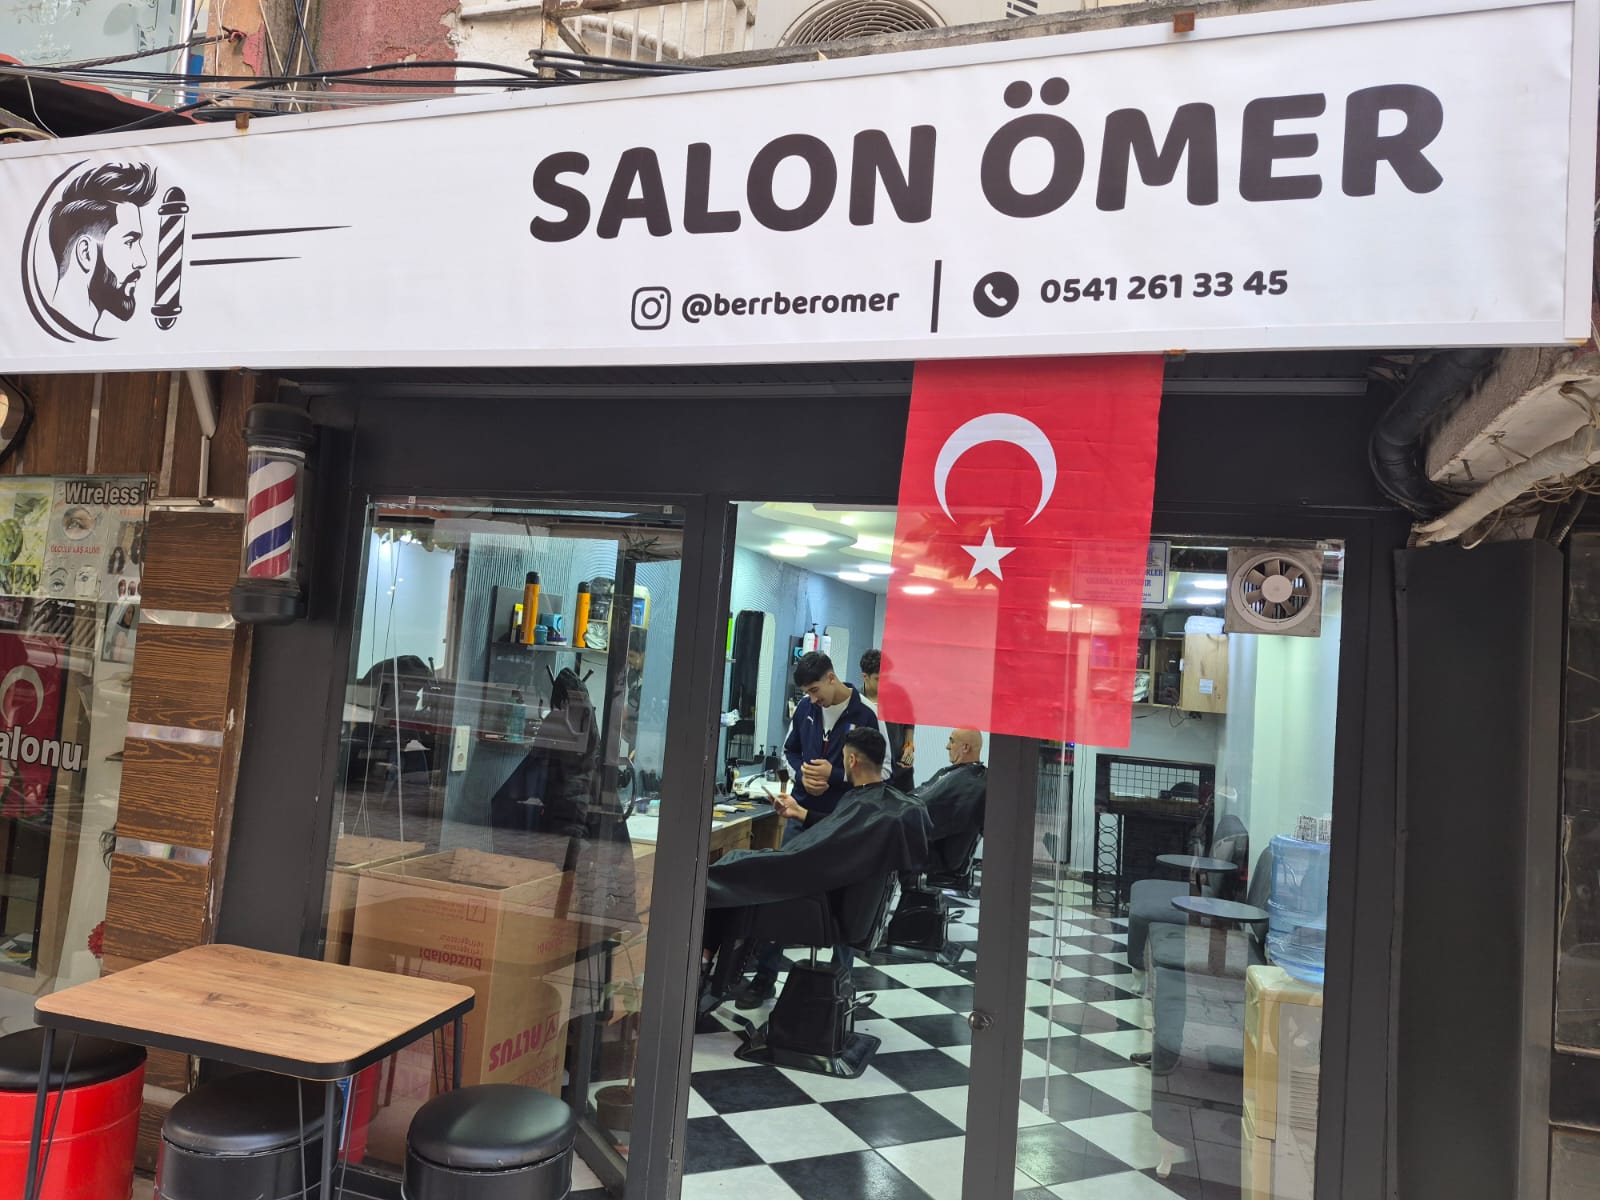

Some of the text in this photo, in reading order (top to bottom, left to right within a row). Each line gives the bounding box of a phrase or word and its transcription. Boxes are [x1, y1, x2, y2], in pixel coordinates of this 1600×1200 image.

[529, 76, 1444, 243] SALON ÖMER
[1040, 269, 1288, 304] 0541 261 33 45
[681, 292, 900, 324] @berrberomer
[488, 1025, 541, 1072] ALTUS
